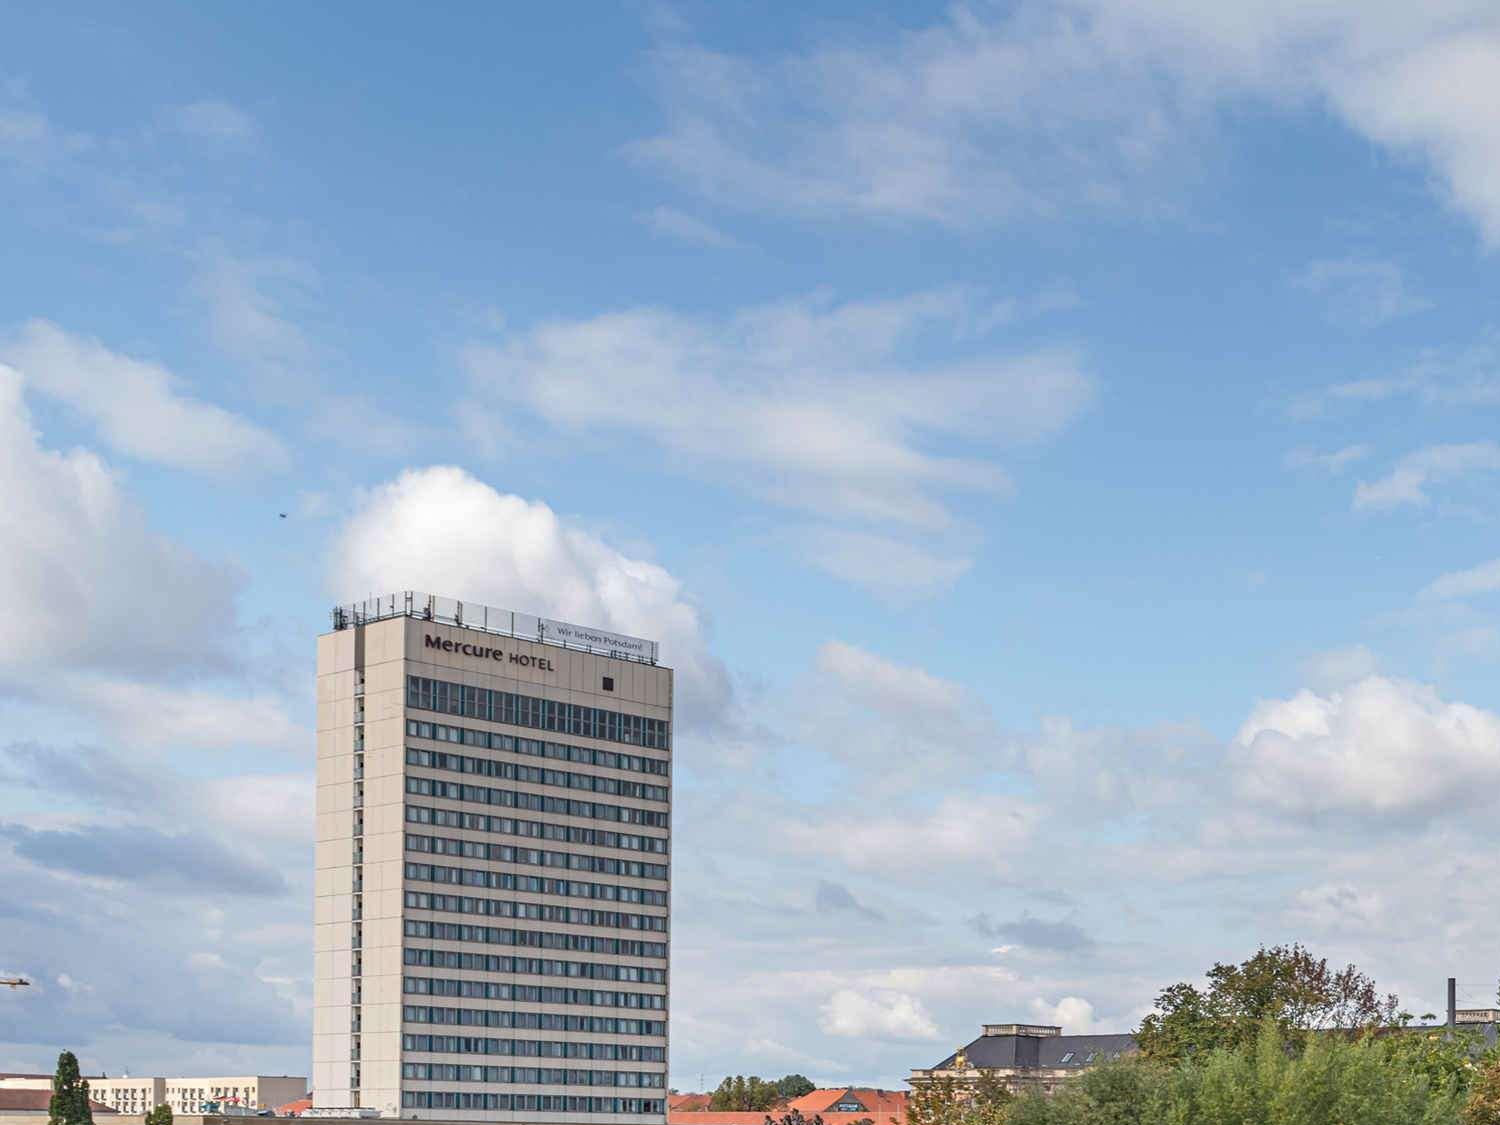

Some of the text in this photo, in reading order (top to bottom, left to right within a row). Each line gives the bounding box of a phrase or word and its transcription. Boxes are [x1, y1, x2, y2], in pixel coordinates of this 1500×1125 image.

[557, 627, 573, 637] Wir
[575, 631, 602, 642] lieben
[424, 634, 554, 671] Mercure HOTEL
